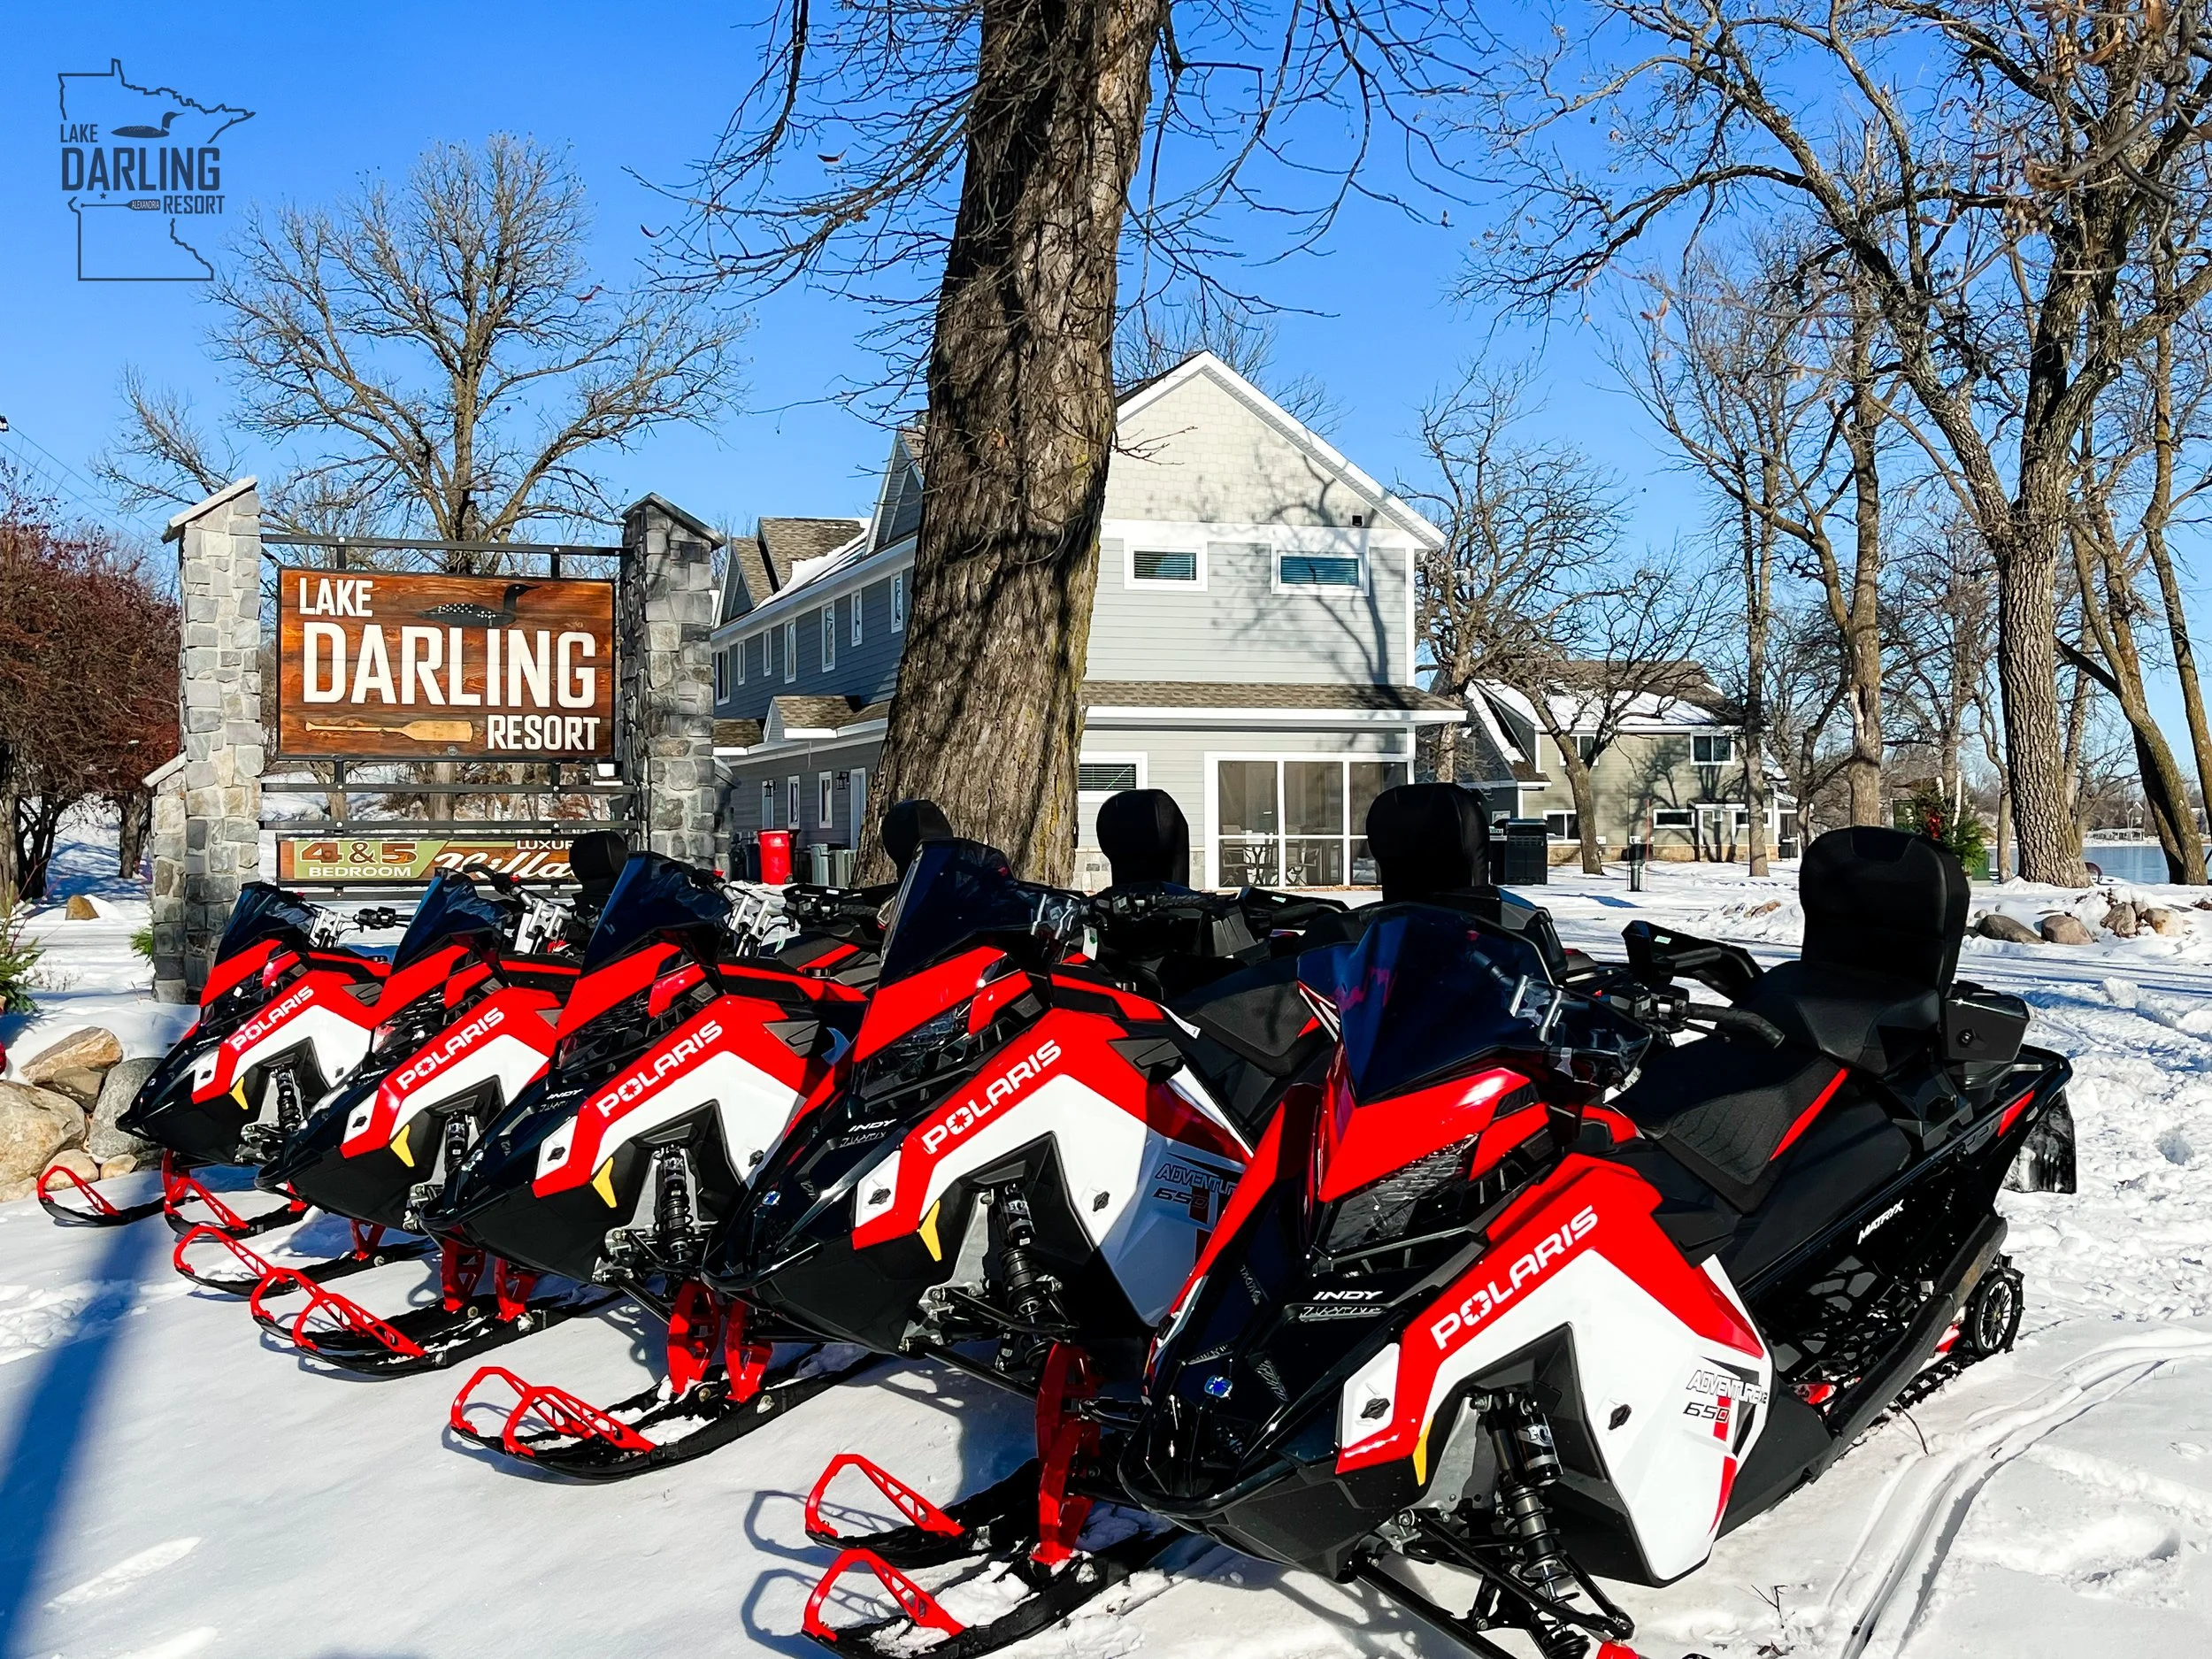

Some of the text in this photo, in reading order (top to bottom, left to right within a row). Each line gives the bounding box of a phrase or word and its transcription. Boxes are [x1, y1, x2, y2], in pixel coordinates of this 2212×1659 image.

[299, 577, 373, 618] LAKE
[303, 621, 595, 709] DARLING
[487, 714, 601, 751] RESORT
[516, 840, 574, 850] LUXUR
[309, 866, 412, 878] BEDROOM
[434, 851, 575, 880] Villa
[229, 985, 314, 1052] POLARIS
[396, 1007, 504, 1091] POLARIS
[595, 1019, 723, 1118] POLARIS
[920, 1039, 1063, 1155] POLARIS
[848, 1118, 898, 1133] INDY
[1153, 1187, 1210, 1210] 650
[1857, 1198, 1904, 1245] MATRYX
[1430, 1204, 1599, 1350] POLARIS
[1312, 1291, 1383, 1301] INDY
[1683, 1401, 1730, 1422] 650
[1526, 1425, 1554, 1446] FO
